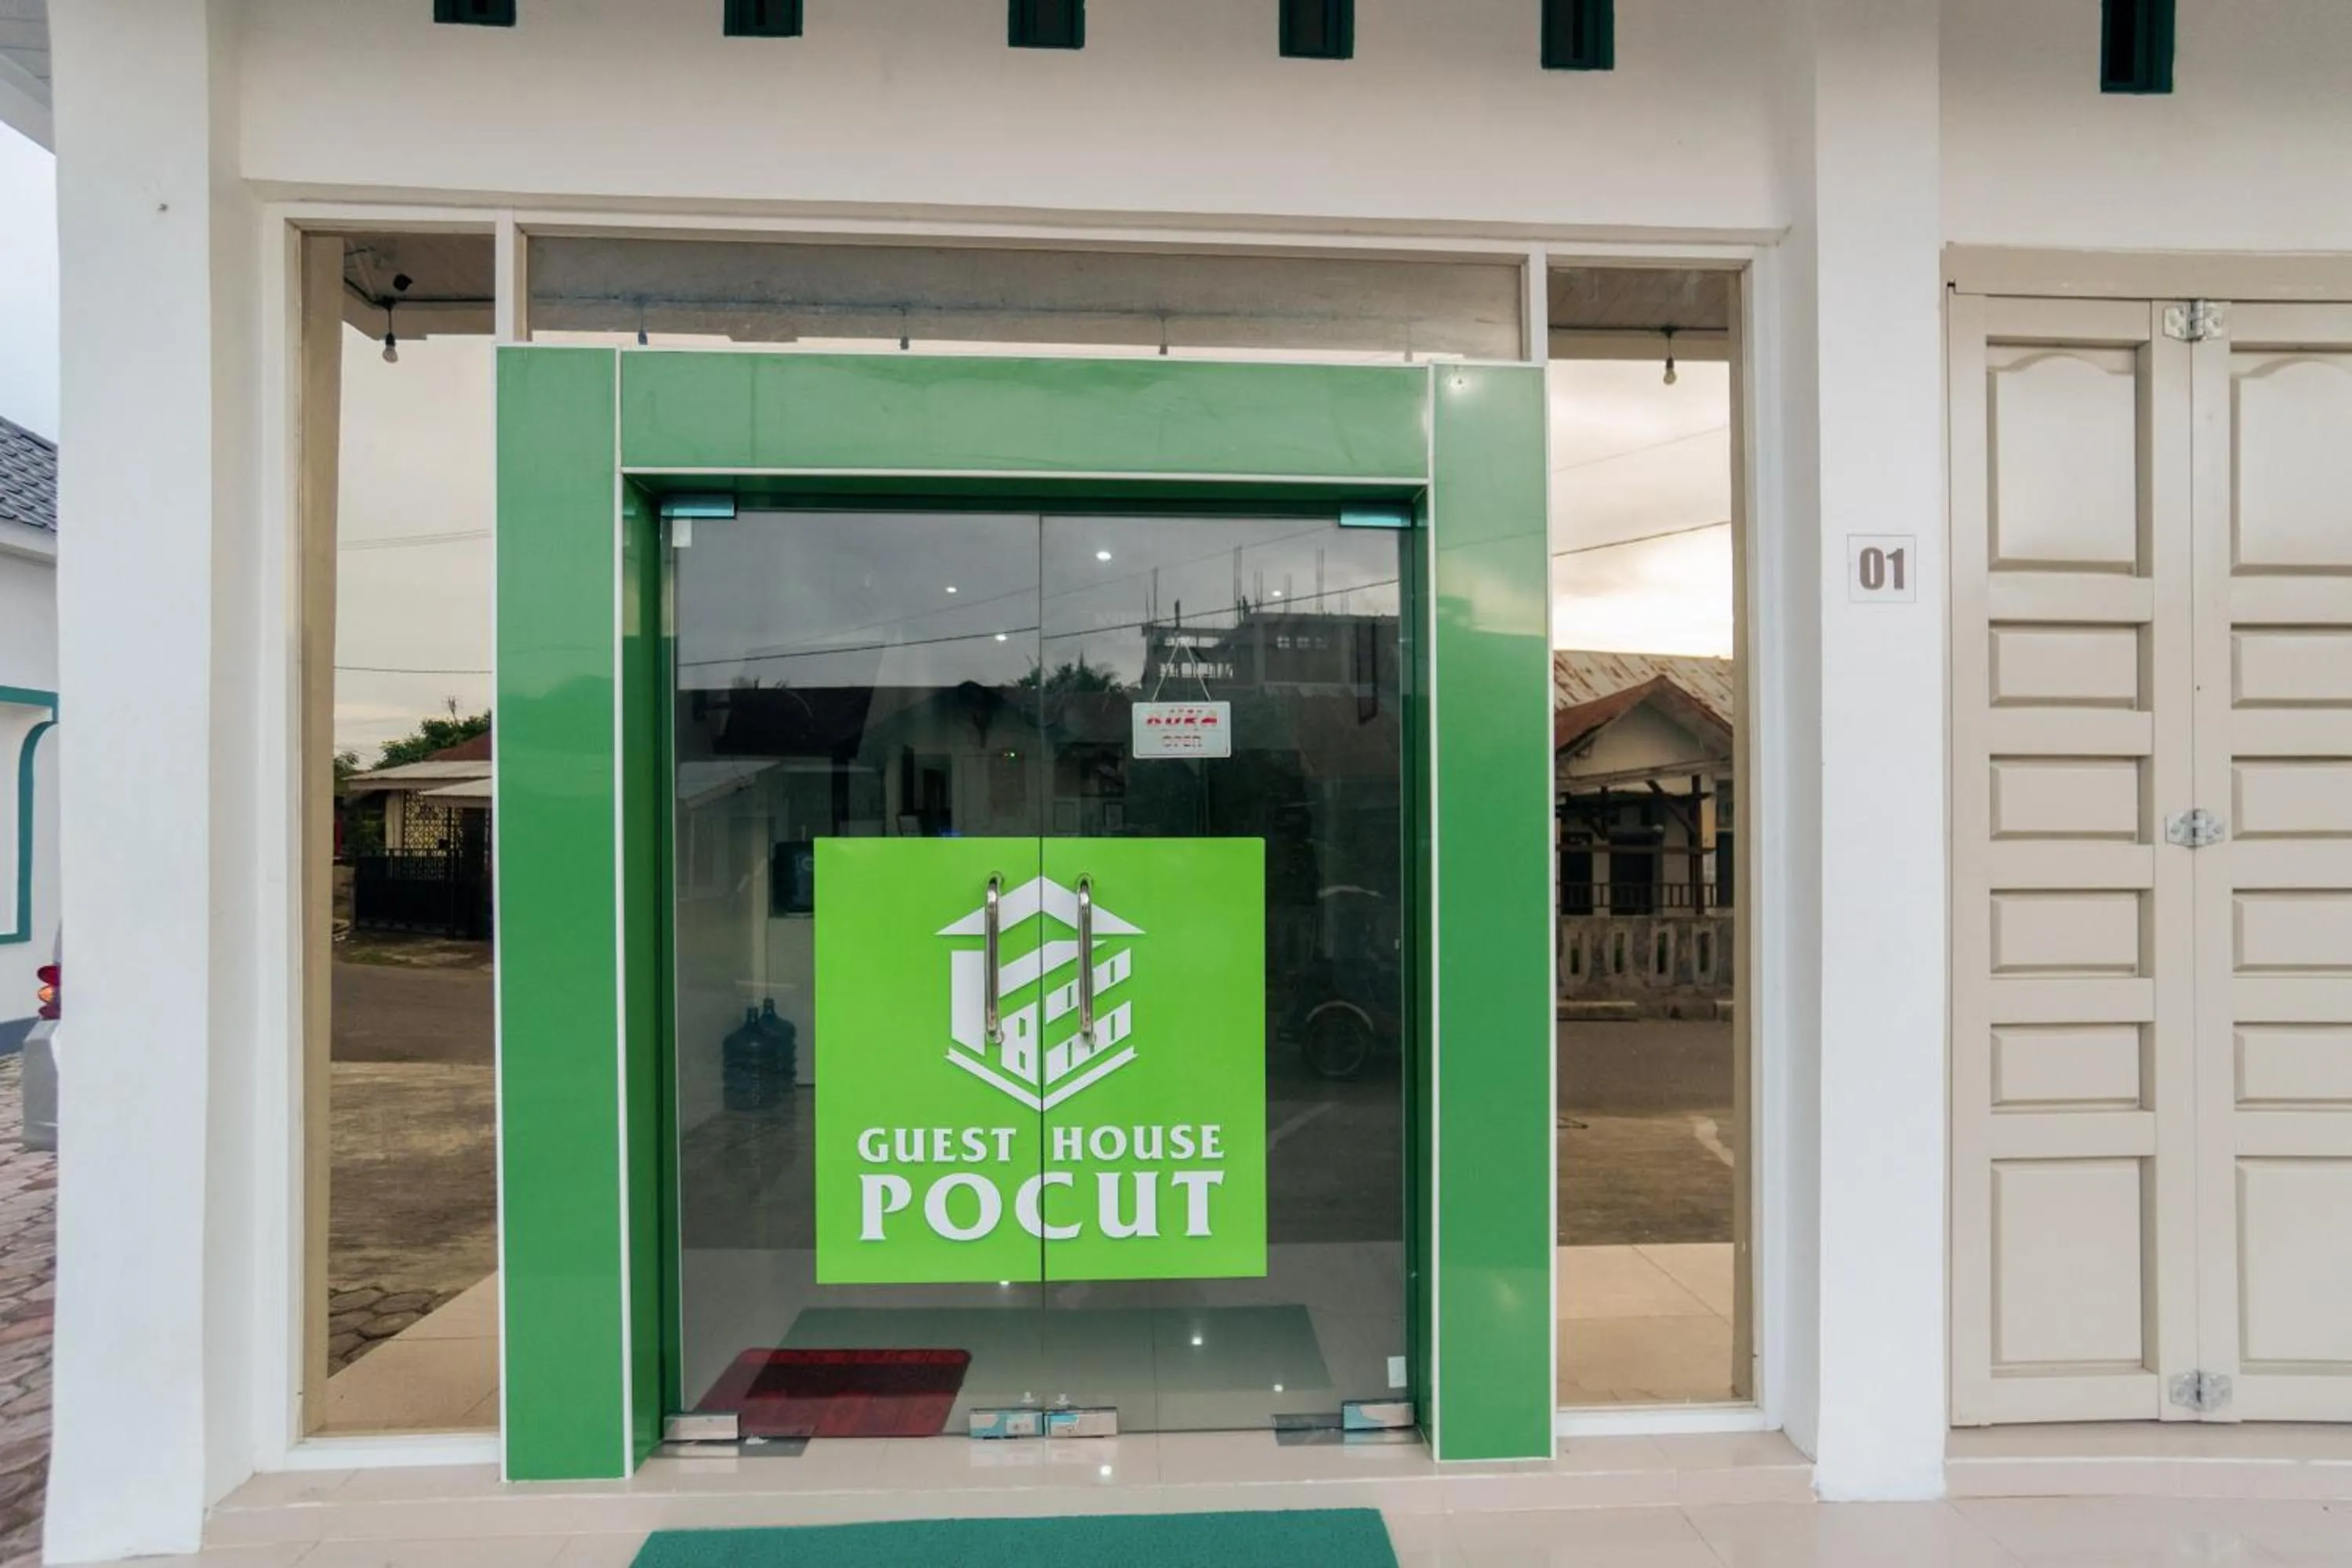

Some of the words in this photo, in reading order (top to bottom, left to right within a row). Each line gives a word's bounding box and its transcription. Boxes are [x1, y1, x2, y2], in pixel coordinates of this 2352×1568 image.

[1859, 546, 1904, 590] 01
[857, 1127, 1017, 1163] GUEST
[1052, 1124, 1225, 1161] HOUSE
[859, 1171, 1225, 1241] POCUT
